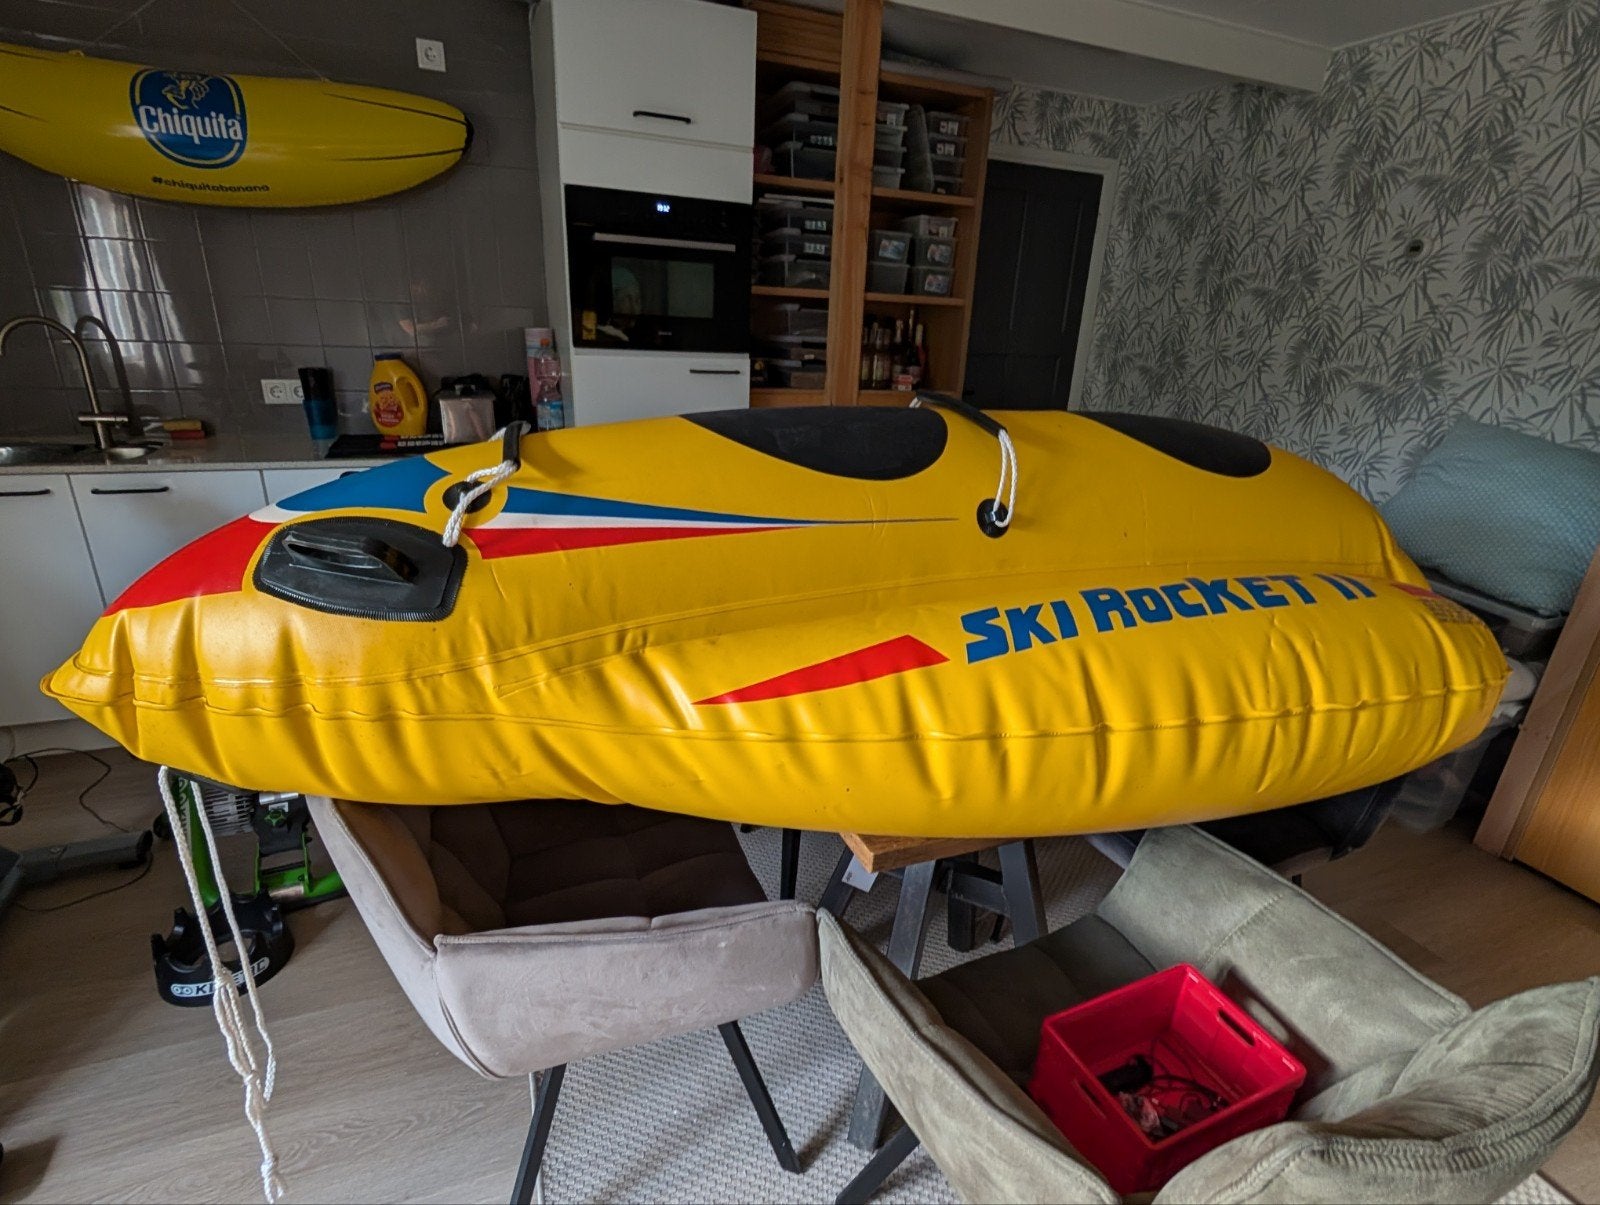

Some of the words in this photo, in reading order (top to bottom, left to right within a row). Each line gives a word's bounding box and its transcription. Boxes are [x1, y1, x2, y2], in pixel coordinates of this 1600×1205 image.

[138, 105, 244, 145] Chiquita
[960, 599, 1080, 665] SKI
[1079, 573, 1318, 633] ROCKET
[1313, 572, 1378, 601] II
